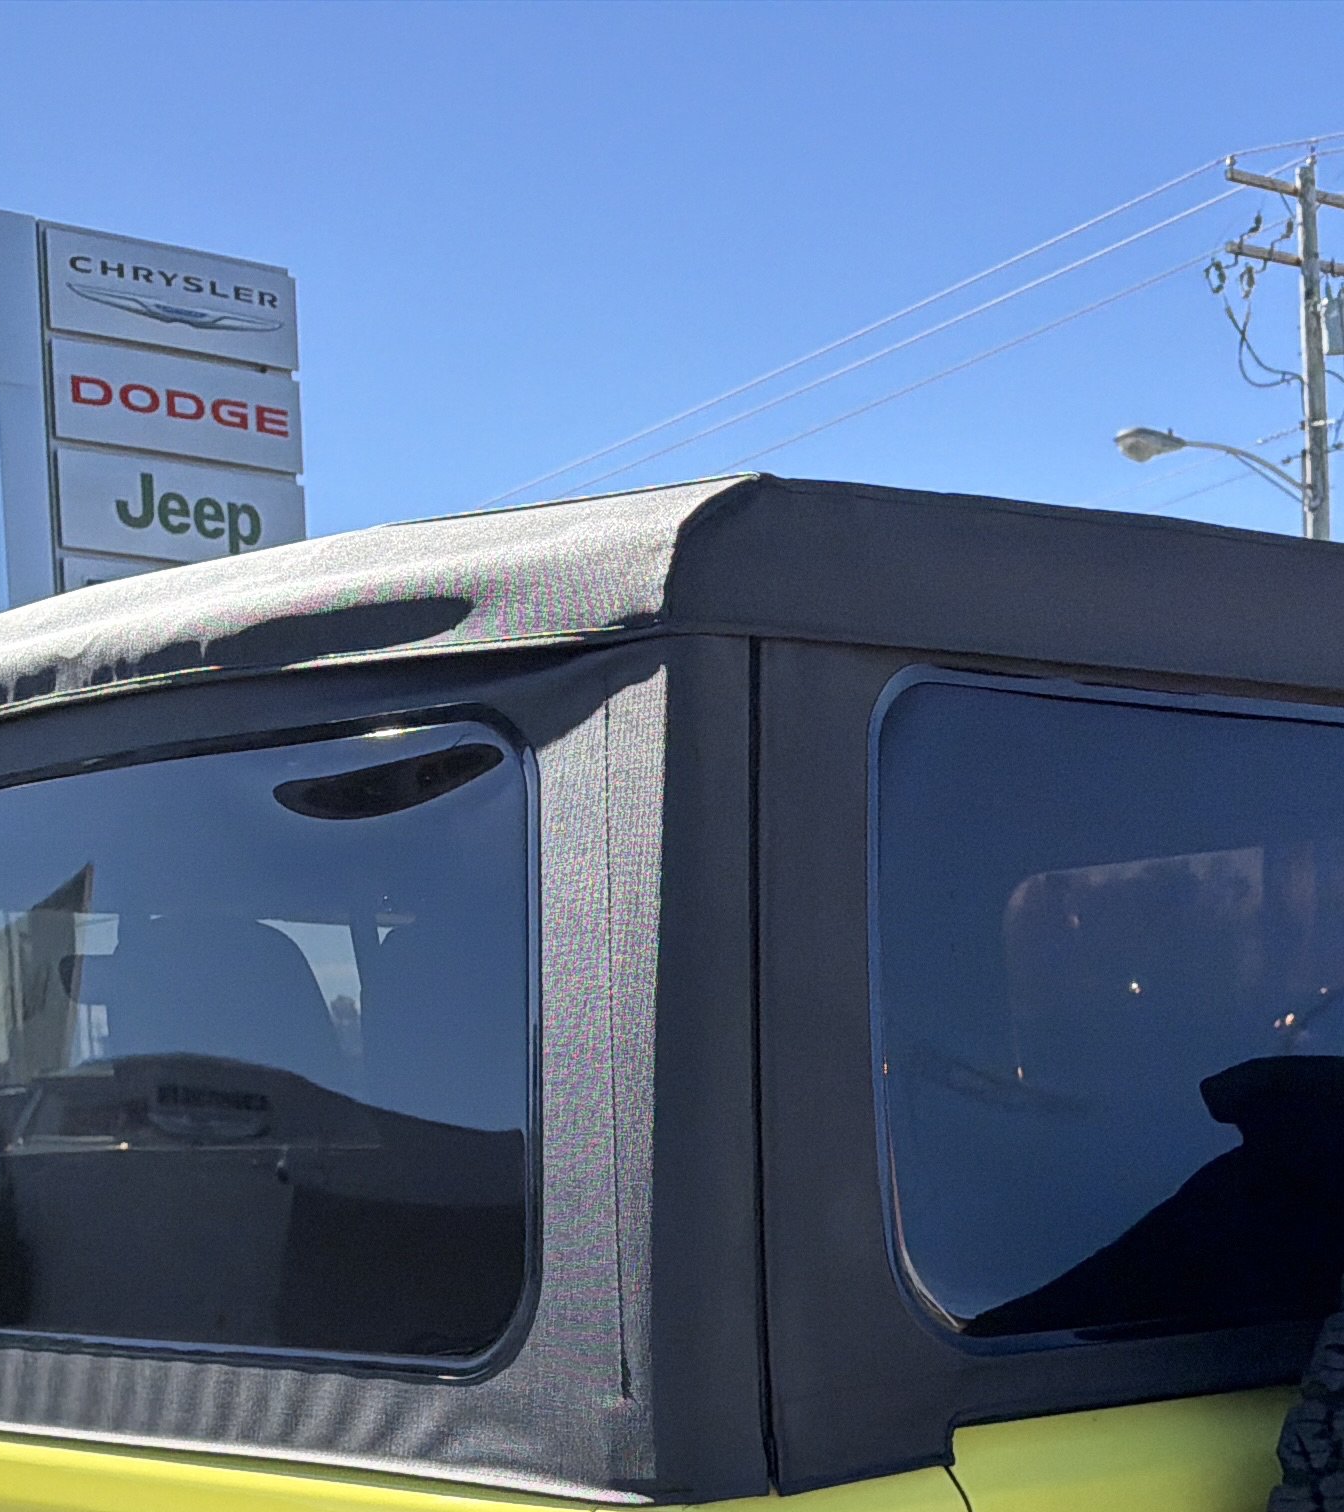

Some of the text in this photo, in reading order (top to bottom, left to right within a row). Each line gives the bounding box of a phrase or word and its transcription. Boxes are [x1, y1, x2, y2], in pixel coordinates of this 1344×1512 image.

[69, 255, 279, 309] CHRYSLER
[70, 374, 289, 438] DODGE
[114, 472, 262, 554] Jeep
